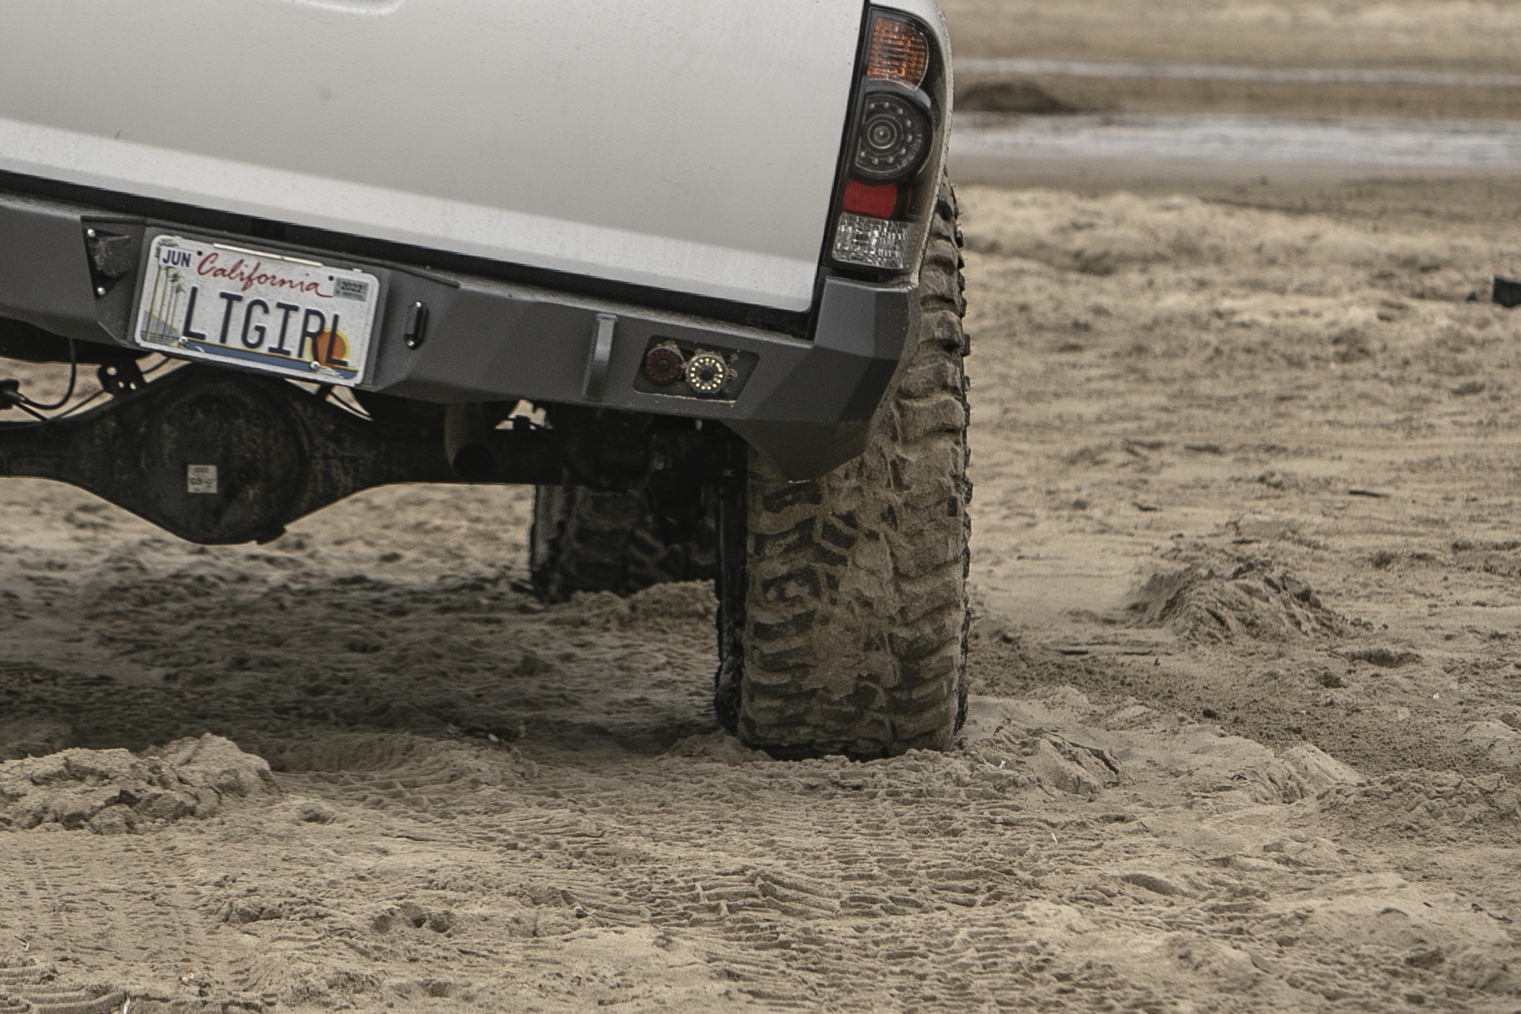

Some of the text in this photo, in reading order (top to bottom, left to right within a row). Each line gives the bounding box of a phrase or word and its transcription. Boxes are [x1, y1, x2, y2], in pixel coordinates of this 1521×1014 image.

[162, 249, 192, 268] JUN
[196, 251, 334, 298] California
[182, 286, 349, 367] LTGIRL
